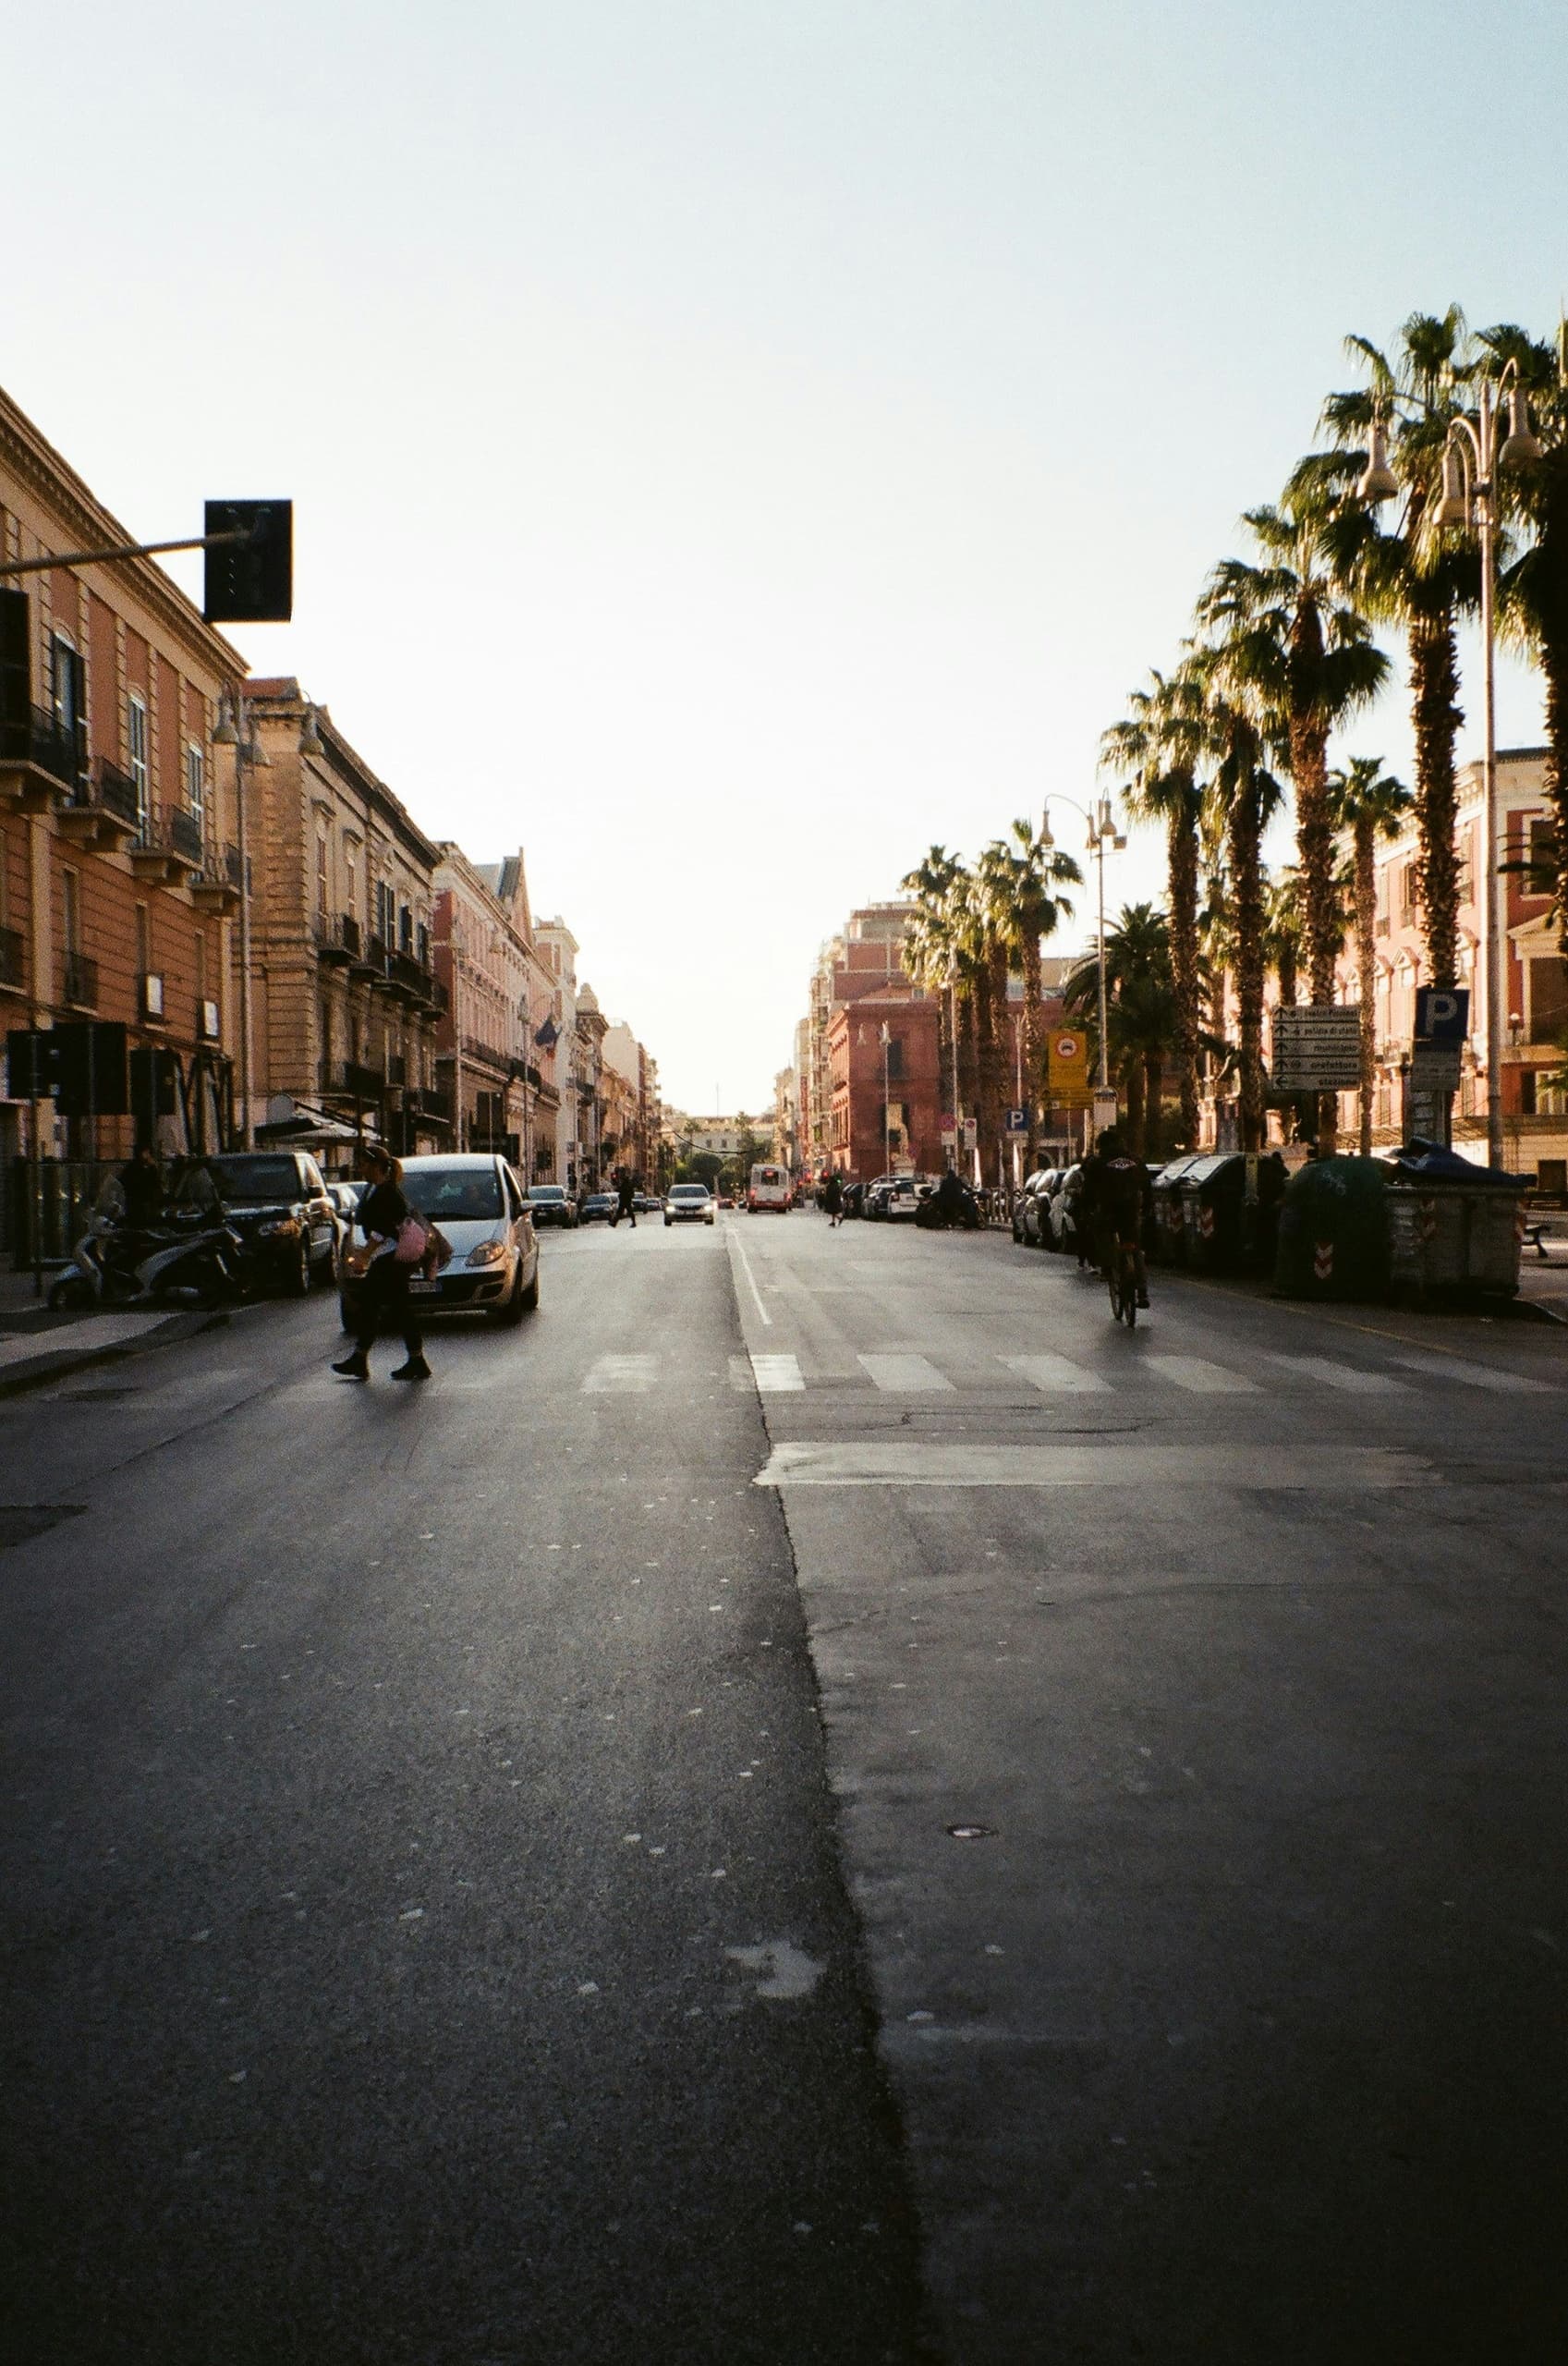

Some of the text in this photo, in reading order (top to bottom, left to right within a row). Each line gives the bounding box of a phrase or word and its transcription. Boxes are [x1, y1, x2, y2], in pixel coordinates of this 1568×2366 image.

[1426, 994, 1458, 1033] P
[1314, 1044, 1357, 1053] municipio
[1011, 1111, 1024, 1128] P
